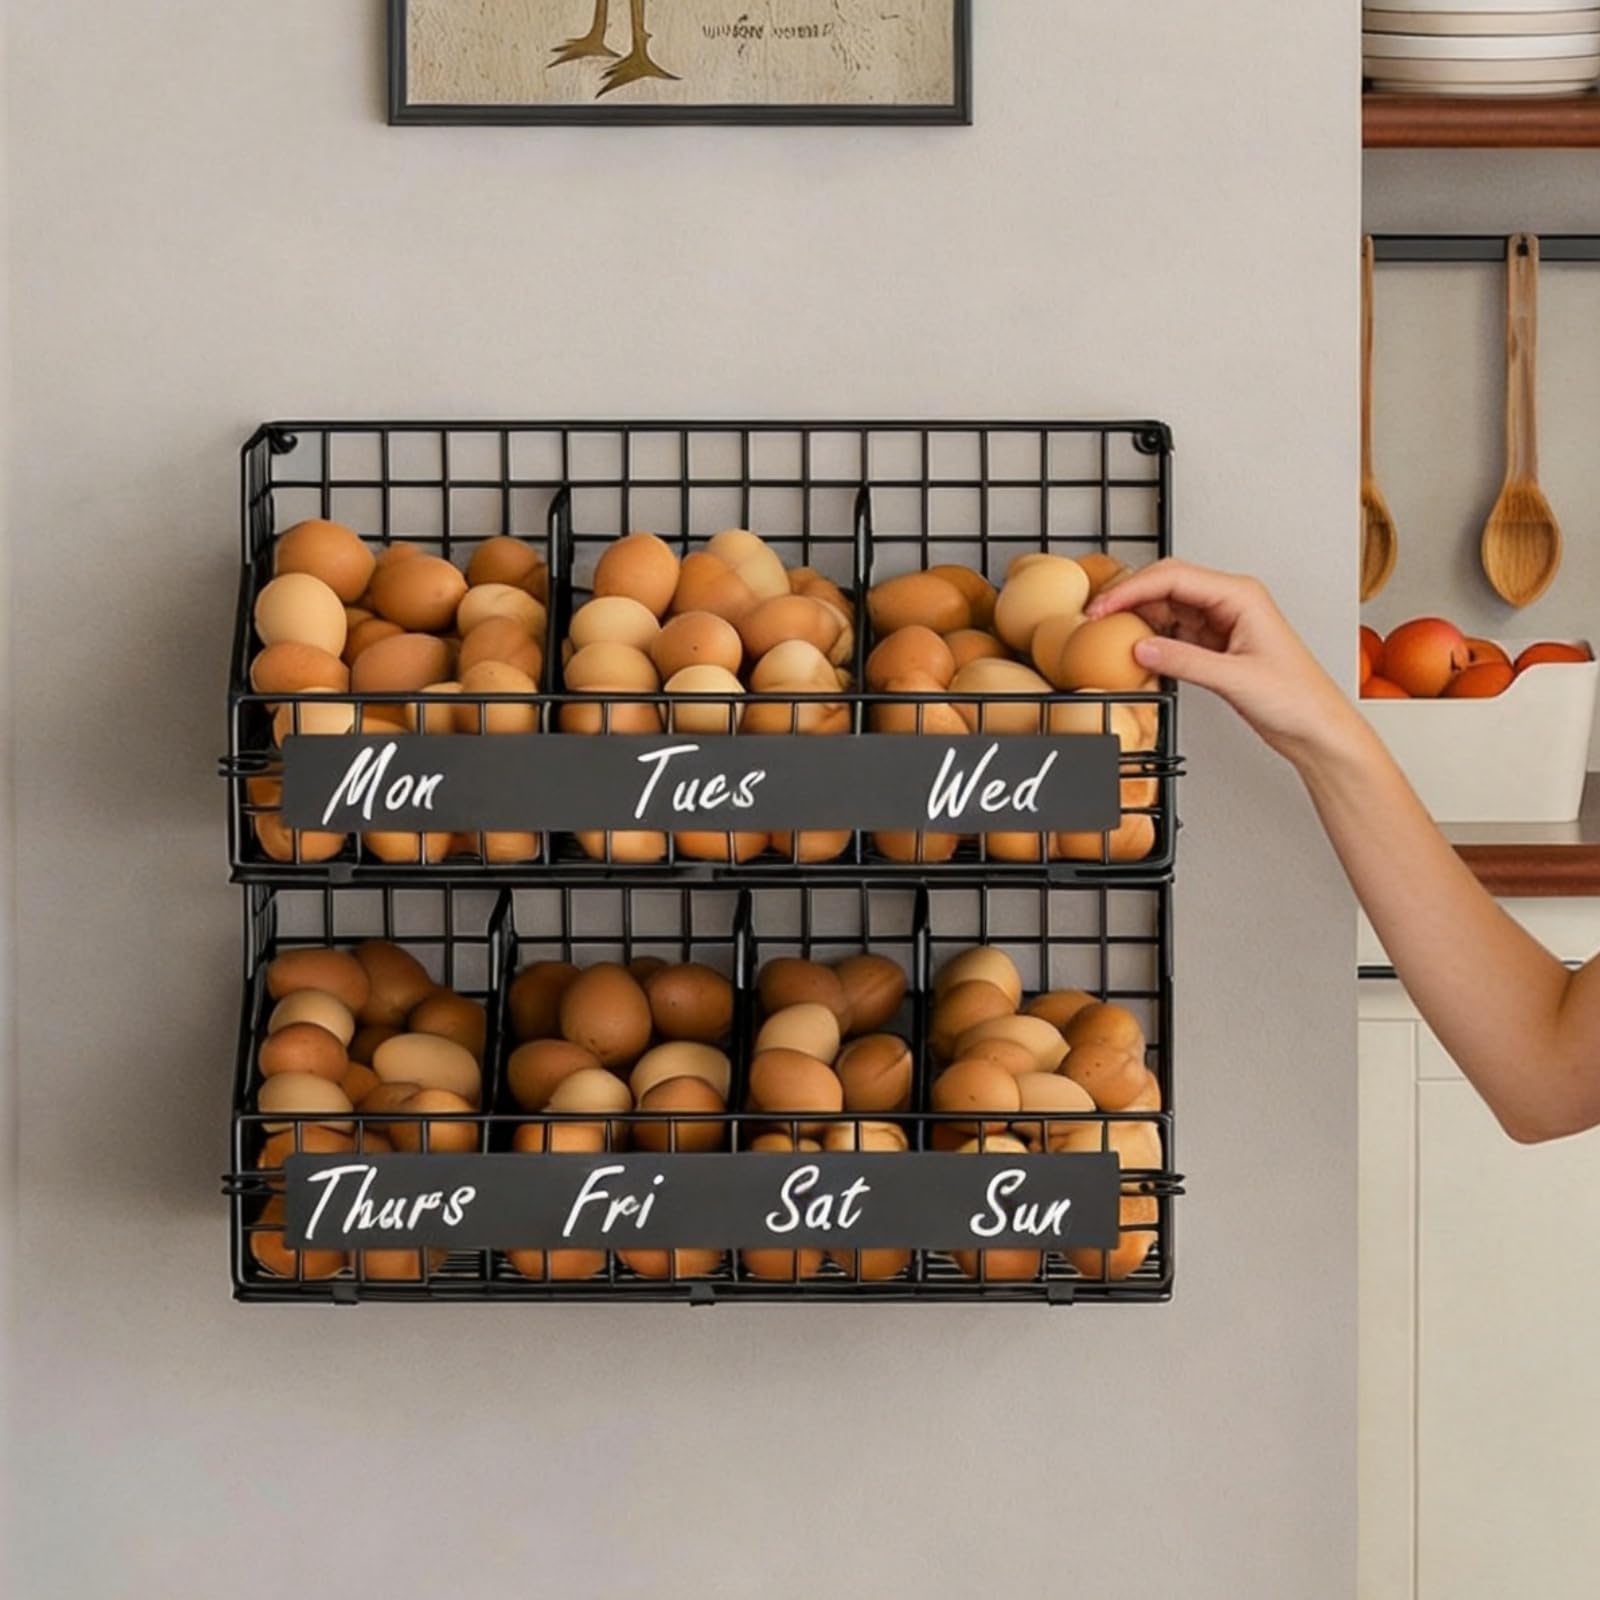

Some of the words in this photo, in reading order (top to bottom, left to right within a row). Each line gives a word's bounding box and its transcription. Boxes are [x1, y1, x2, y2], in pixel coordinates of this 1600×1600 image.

[322, 742, 444, 826] Mon
[635, 744, 766, 819] Tues
[927, 742, 1057, 821] Wed
[306, 1165, 476, 1240] Thurs
[563, 1166, 665, 1237] Fri
[766, 1165, 871, 1233] Sat
[970, 1169, 1072, 1237] Sun
